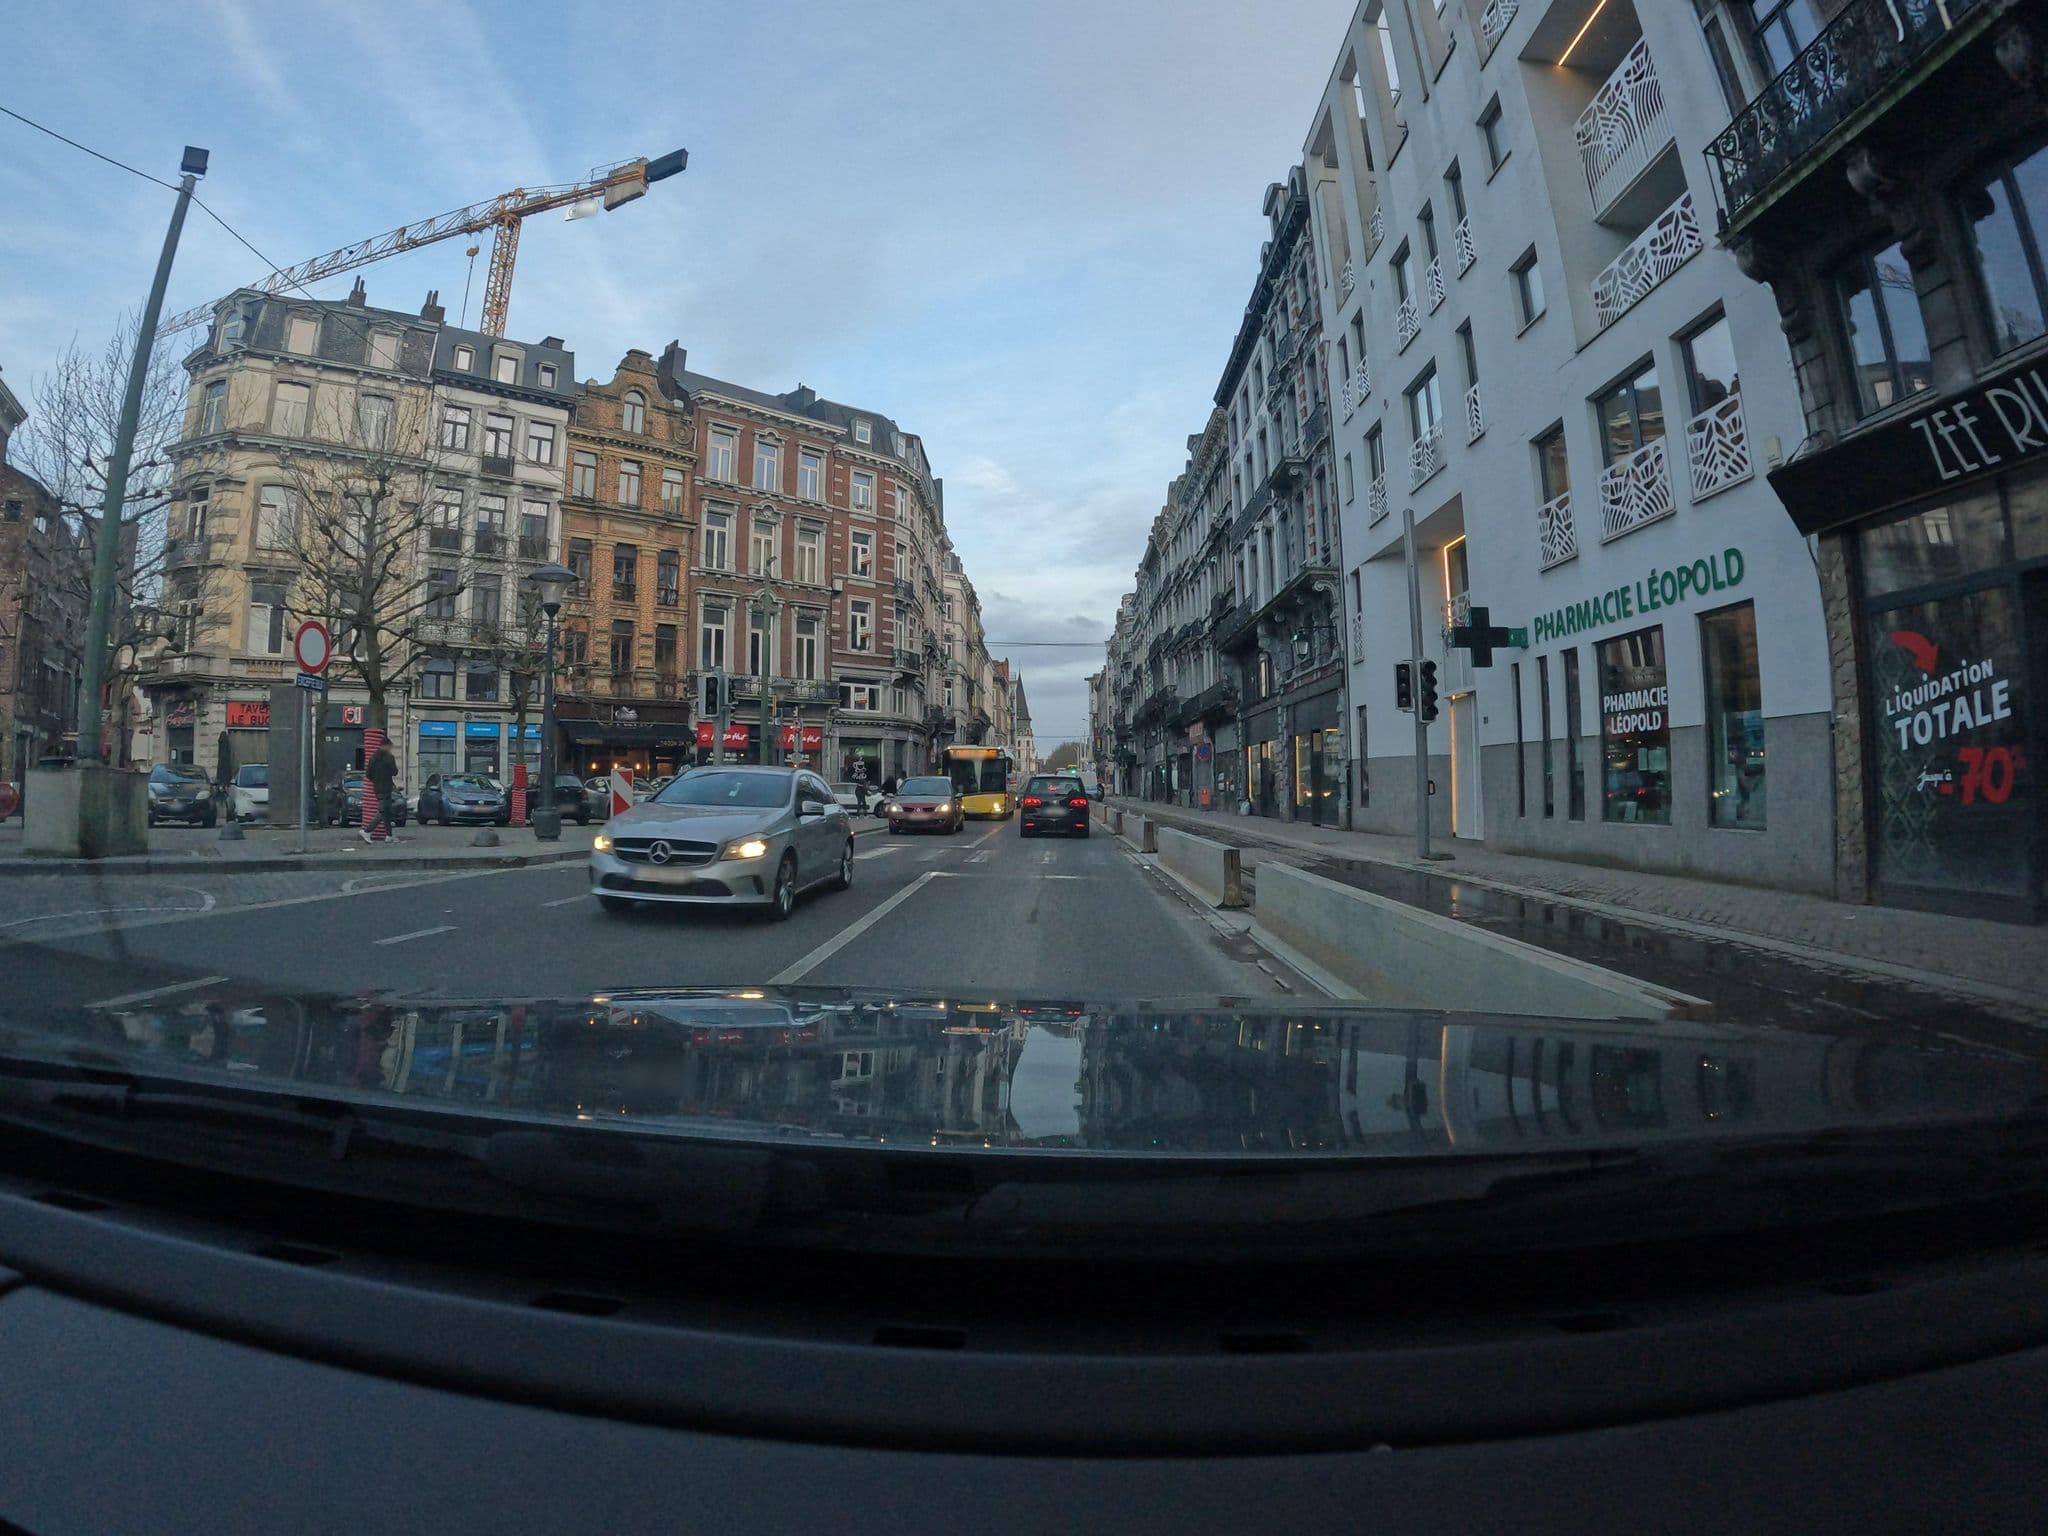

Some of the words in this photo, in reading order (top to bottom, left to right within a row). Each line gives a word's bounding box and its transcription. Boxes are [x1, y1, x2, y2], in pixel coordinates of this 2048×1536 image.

[1910, 400, 2001, 480] ZEE
[1534, 585, 1634, 644] PHARMACIE
[1636, 547, 1744, 614] LÉOPOLD
[232, 715, 244, 725] LE
[1603, 686, 1668, 713] PHARMACIE
[1611, 711, 1662, 734] LÉOPOLD
[1895, 679, 2012, 750] TOTALE
